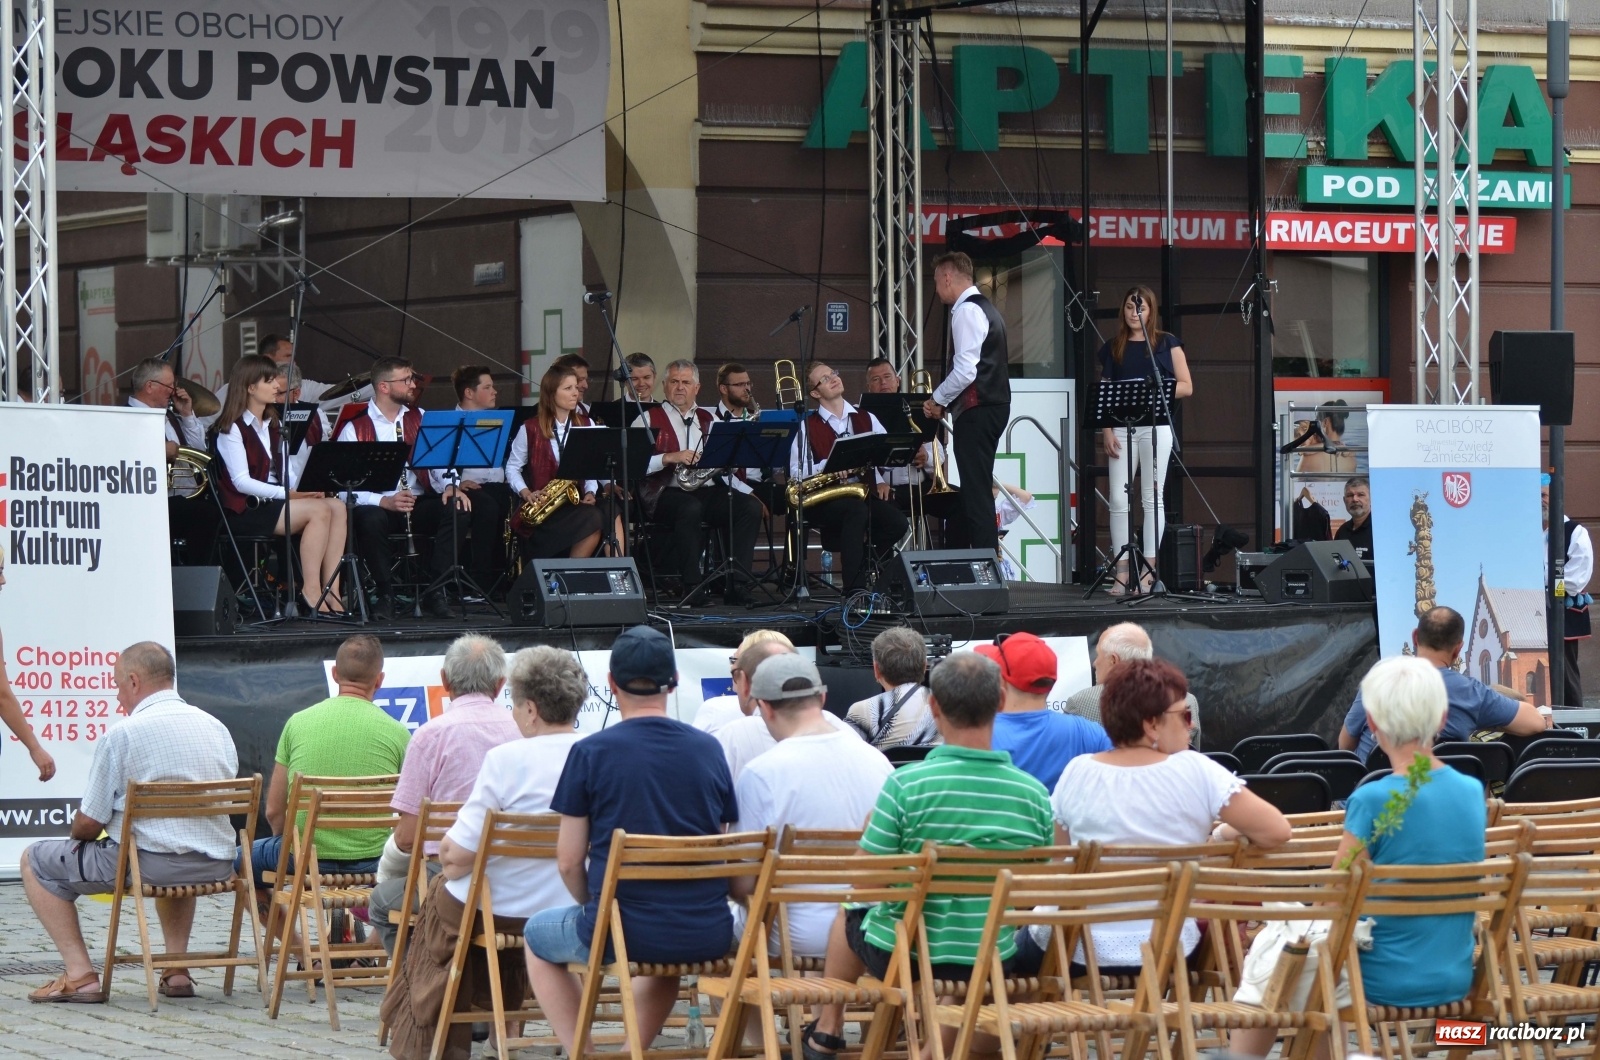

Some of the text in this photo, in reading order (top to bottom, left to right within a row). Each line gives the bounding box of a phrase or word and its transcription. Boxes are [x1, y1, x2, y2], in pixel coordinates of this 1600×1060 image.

[14, 8, 344, 42] MEJSKIE OBCHODY
[237, 46, 555, 109] POWSTAŃ
[1322, 174, 1400, 198] POD
[1078, 215, 1224, 240] CENTRUM
[831, 312, 843, 326] 12
[286, 411, 309, 420] Tenor
[1416, 415, 1493, 434] RACIBÓRZ
[1457, 440, 1494, 452] Zwiedź
[1423, 449, 1491, 465] Zamieszkaj
[10, 456, 158, 495] Raciborskie
[10, 530, 102, 572] Kultury
[40, 699, 79, 718] 412
[85, 699, 109, 718] 32
[41, 723, 79, 741] 415
